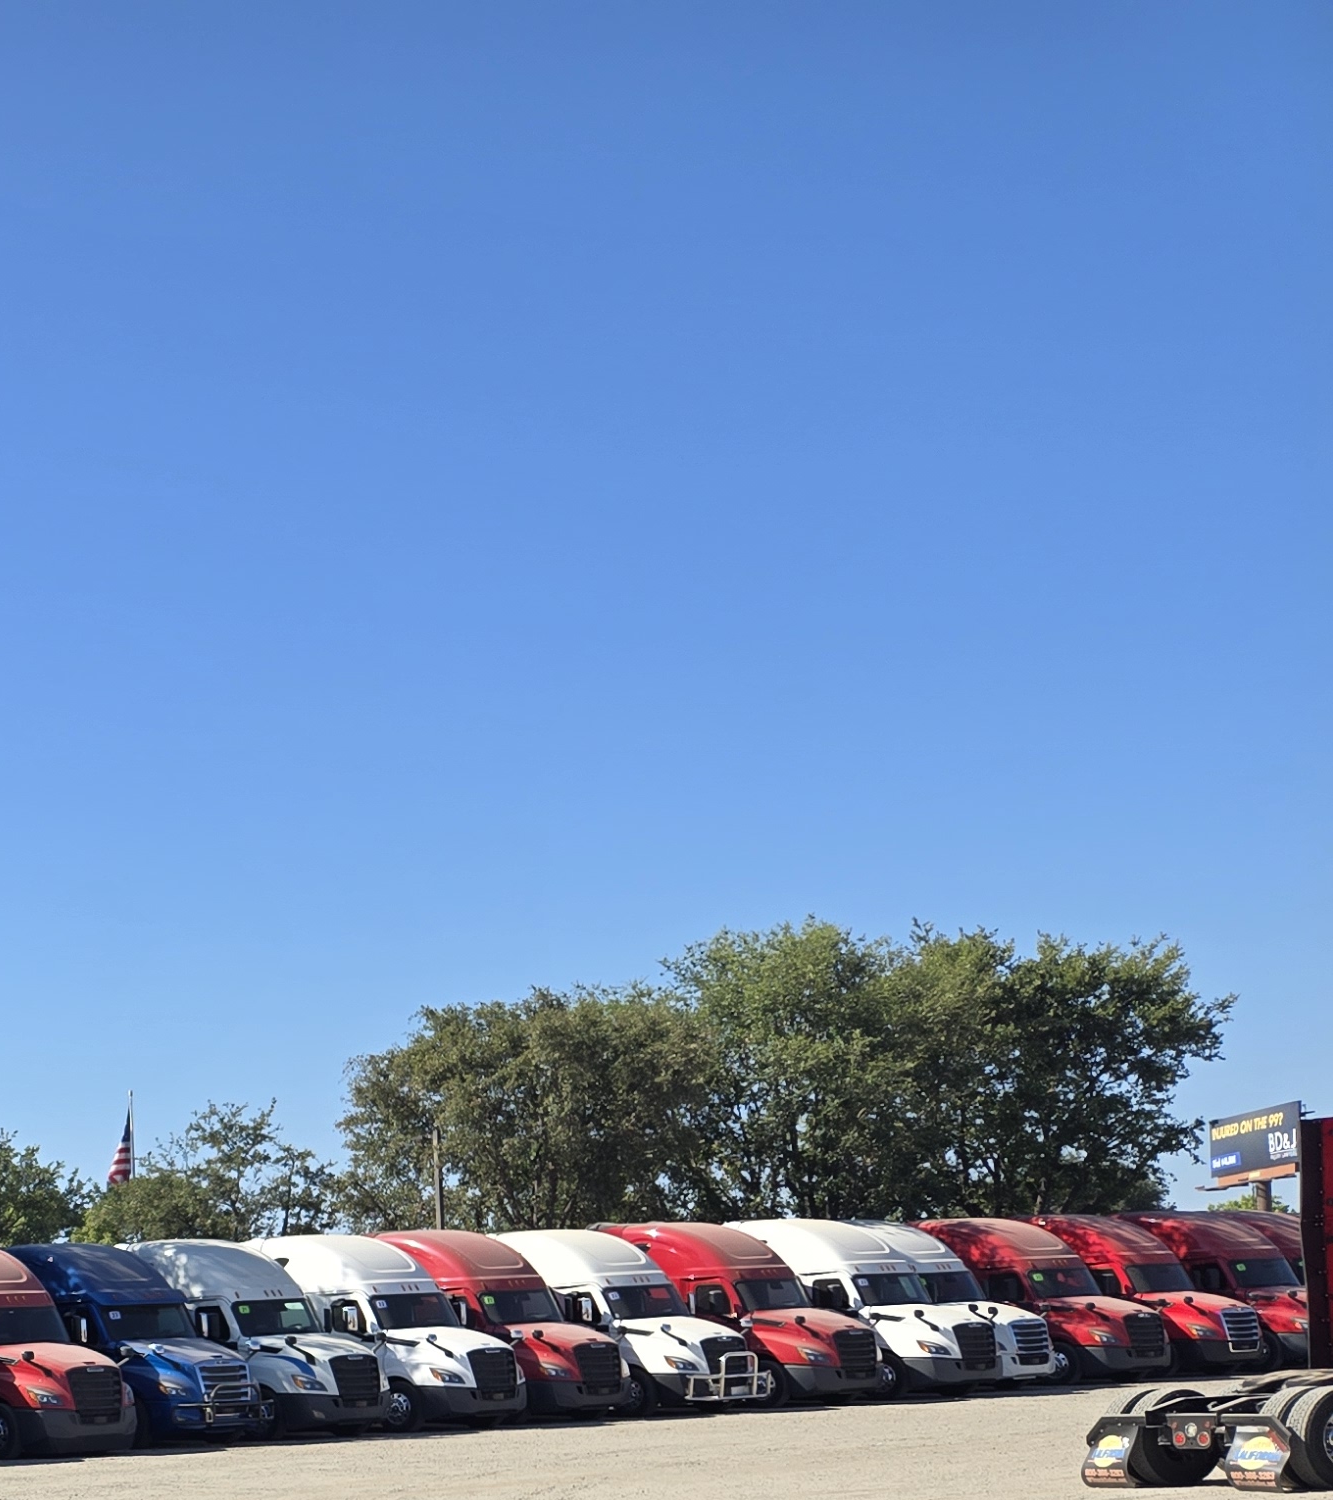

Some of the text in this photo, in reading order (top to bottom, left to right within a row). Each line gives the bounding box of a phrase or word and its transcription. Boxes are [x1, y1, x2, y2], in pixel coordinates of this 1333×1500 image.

[1211, 1112, 1284, 1141] INJURED ON THE 99?
[1267, 1128, 1297, 1153] BD&J
